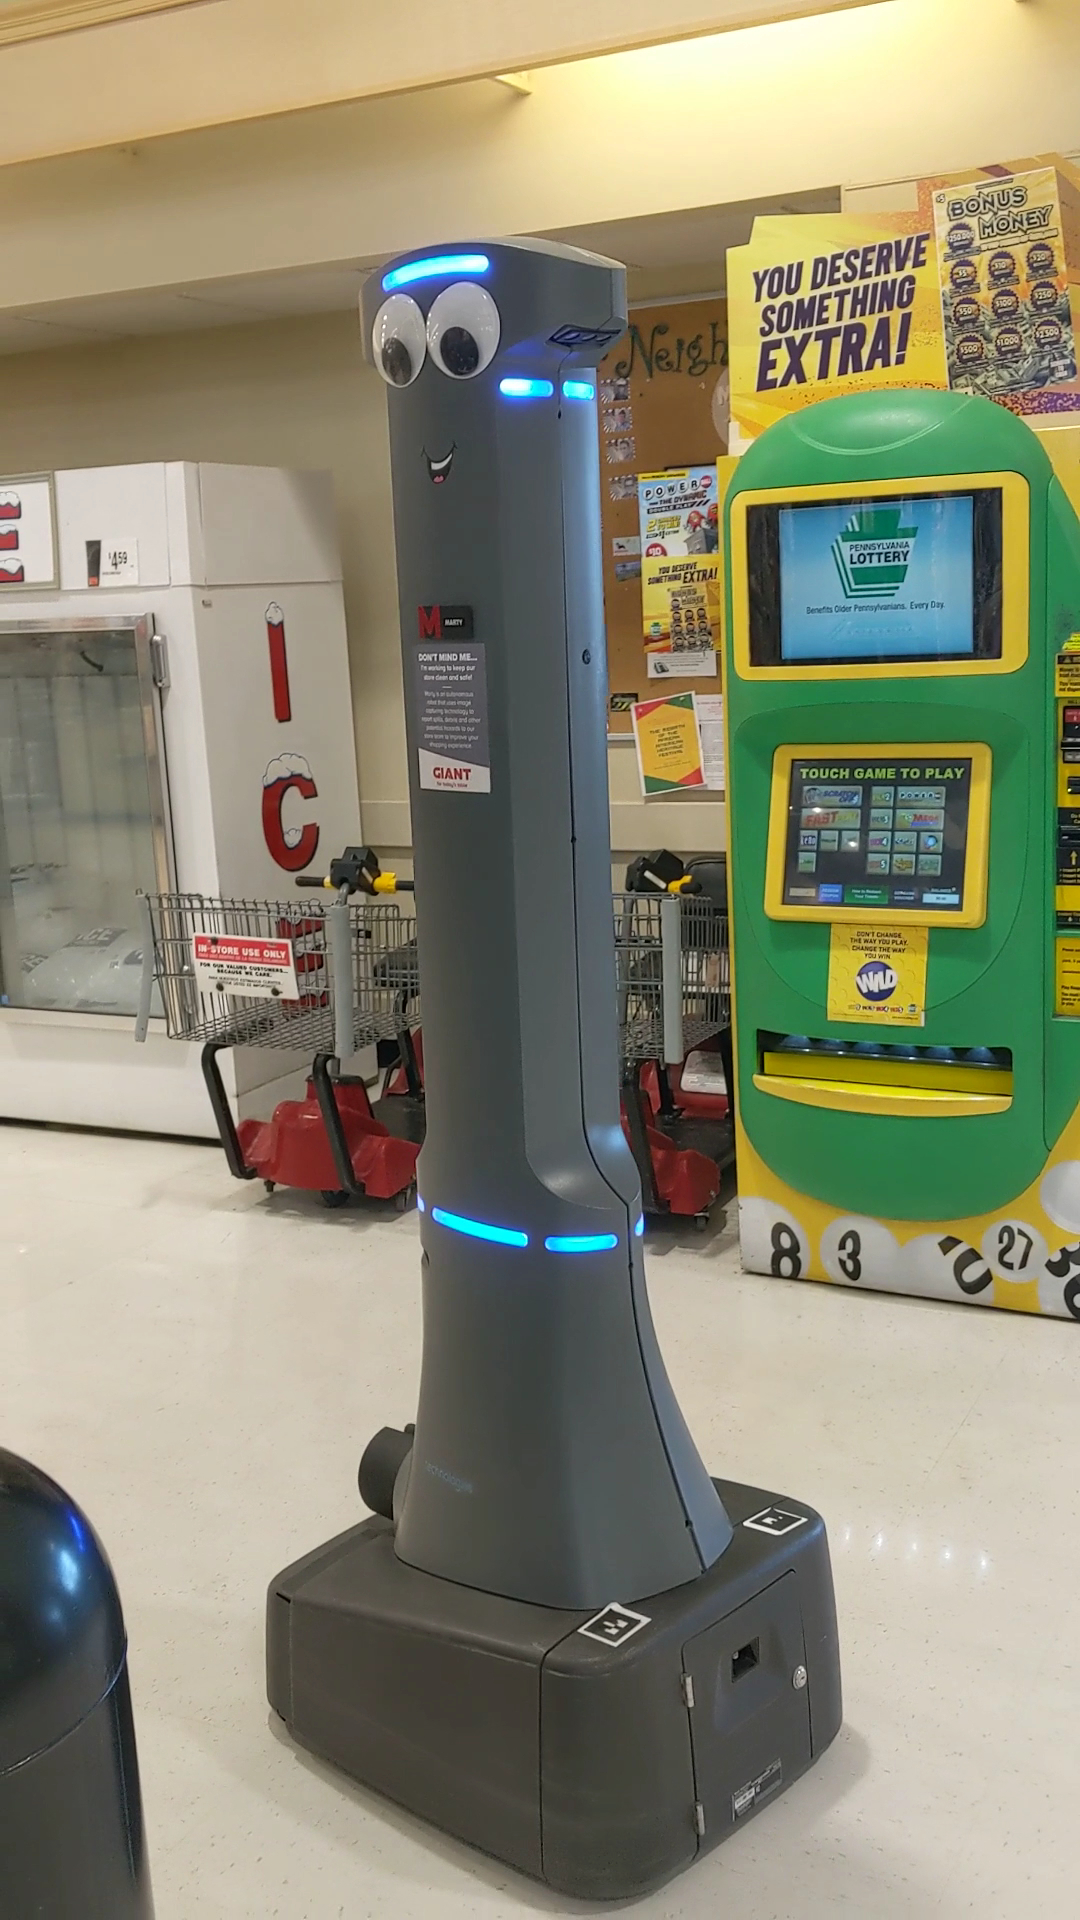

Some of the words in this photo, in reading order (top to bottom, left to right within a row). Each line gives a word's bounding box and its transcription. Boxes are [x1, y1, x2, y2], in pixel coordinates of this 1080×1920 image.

[947, 186, 1028, 221] BONUS
[978, 204, 1054, 240] MONEY
[1032, 253, 1047, 261] $20
[752, 261, 804, 303] YOU
[810, 232, 930, 291] DESERVE
[994, 261, 1007, 270] $10
[1035, 290, 1052, 299] $250
[759, 275, 916, 337] SOMETHING
[995, 299, 1012, 307] $100
[959, 306, 972, 315] $50
[756, 311, 912, 392] EXTRA!
[960, 344, 978, 353] $500
[645, 480, 698, 498] POWER
[647, 519, 656, 532] 2
[849, 541, 910, 552] PENNSYLVANIA
[850, 550, 910, 565] LOTTERY
[659, 566, 670, 575] YOU
[672, 562, 698, 573] DESERVE
[647, 573, 682, 585] SOMETHING
[682, 567, 718, 584] EXTRA!
[806, 606, 833, 614] Benefits
[834, 604, 852, 613] Older
[853, 602, 907, 613] Pennsylvanians.
[909, 601, 929, 611] Every
[930, 600, 945, 609] Day.
[417, 605, 442, 639] M
[444, 618, 463, 626] MARTY
[418, 653, 438, 662] DON'T
[438, 653, 458, 662] MIND
[428, 664, 446, 672] working
[453, 664, 465, 672] keep
[433, 767, 471, 780] GIANT
[800, 767, 850, 780] TOUCH
[854, 767, 896, 780] GAME
[900, 767, 920, 780] TO
[925, 767, 965, 780] PLAY
[198, 944, 239, 955] IN-STORE
[242, 948, 260, 957] USE
[263, 949, 286, 959] ONLY
[856, 968, 898, 993] WILD
[771, 1222, 801, 1280] 8
[838, 1229, 861, 1281] 3
[998, 1225, 1034, 1271] 27
